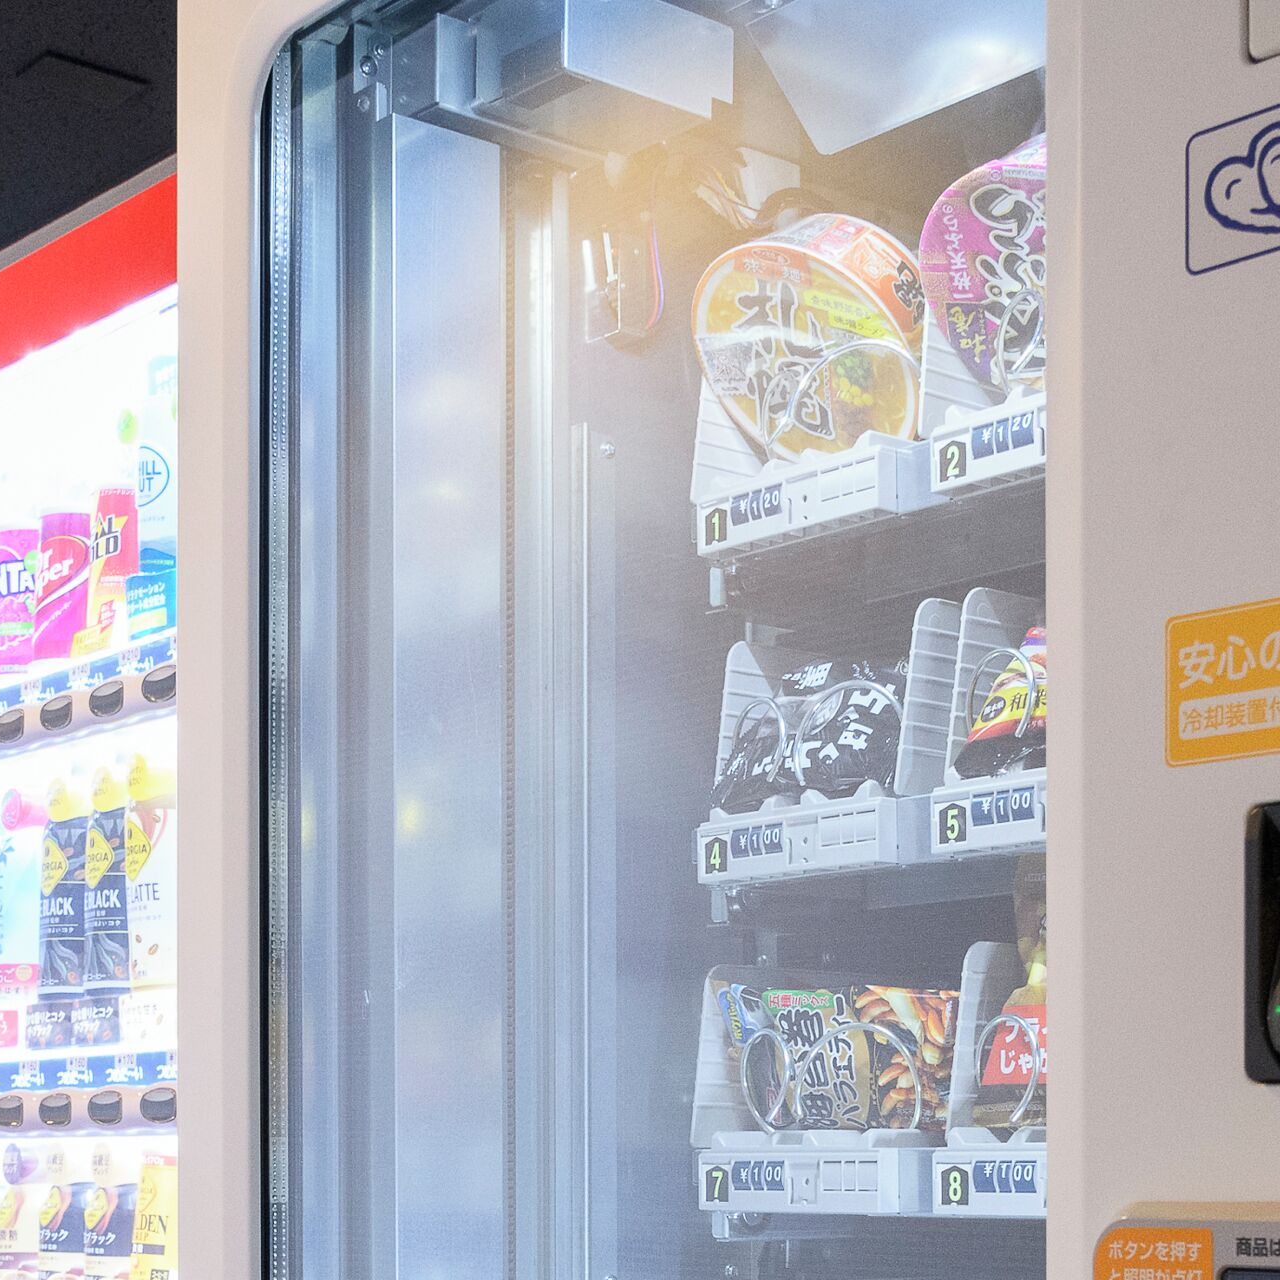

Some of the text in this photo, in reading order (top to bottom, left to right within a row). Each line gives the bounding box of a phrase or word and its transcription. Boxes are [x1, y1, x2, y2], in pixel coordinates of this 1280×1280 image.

[946, 446, 960, 475] 2
[139, 477, 155, 492] UT
[712, 512, 720, 541] 1
[947, 813, 959, 840] 5
[86, 852, 109, 864] ORGIA
[126, 845, 148, 857] ORGIA
[710, 843, 721, 868] 4
[42, 860, 64, 872] ORGIA
[90, 890, 121, 909] BLACK
[131, 882, 160, 903] LATTE
[43, 897, 74, 917] BLACK
[767, 993, 830, 1008] 五種ミックス
[1004, 1017, 1047, 1043] フラ
[826, 995, 867, 1127] バラエティー
[711, 1171, 723, 1197] 7
[949, 1171, 962, 1201] 8
[1108, 1241, 1202, 1262] ボタンを押す
